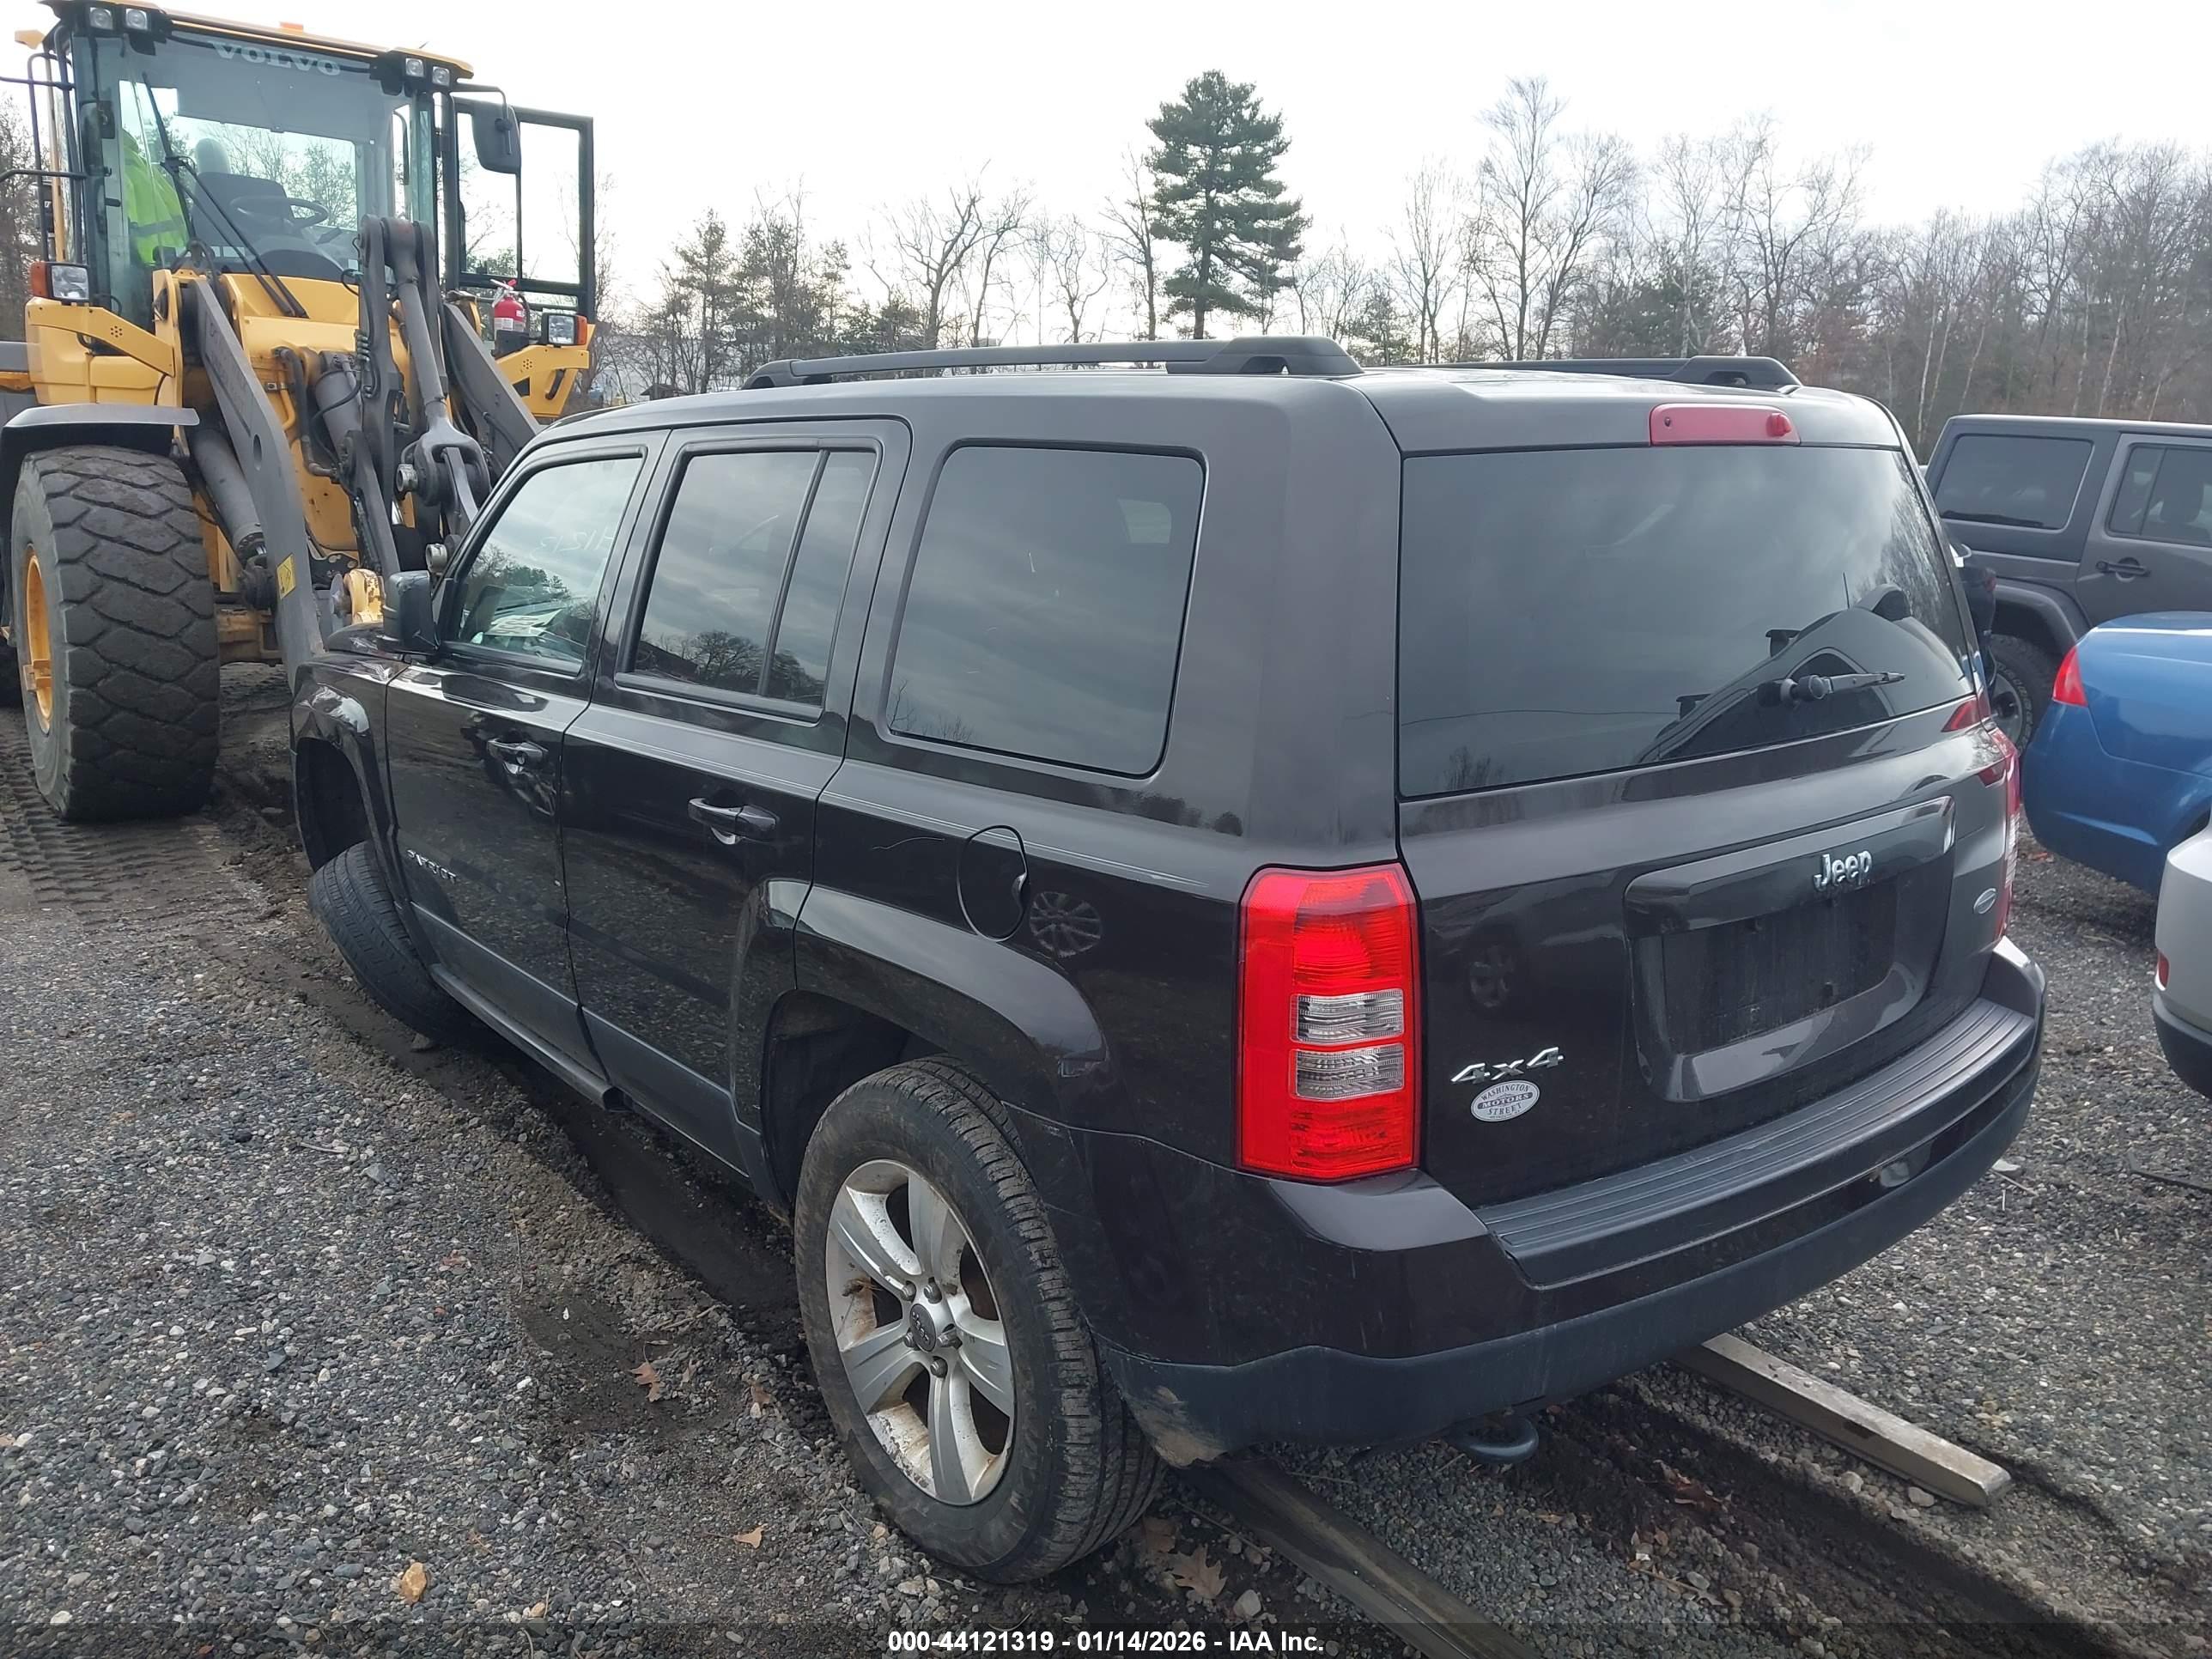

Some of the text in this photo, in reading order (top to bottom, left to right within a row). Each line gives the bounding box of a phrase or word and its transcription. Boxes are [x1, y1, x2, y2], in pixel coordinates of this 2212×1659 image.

[208, 41, 341, 76] VOLVO
[407, 849, 457, 884] PATRIOT
[1813, 850, 1872, 891] Jeep
[1480, 1084, 1530, 1102] WASHINGTON
[1481, 1093, 1530, 1109] MOTORS
[1487, 1102, 1522, 1115] STREET
